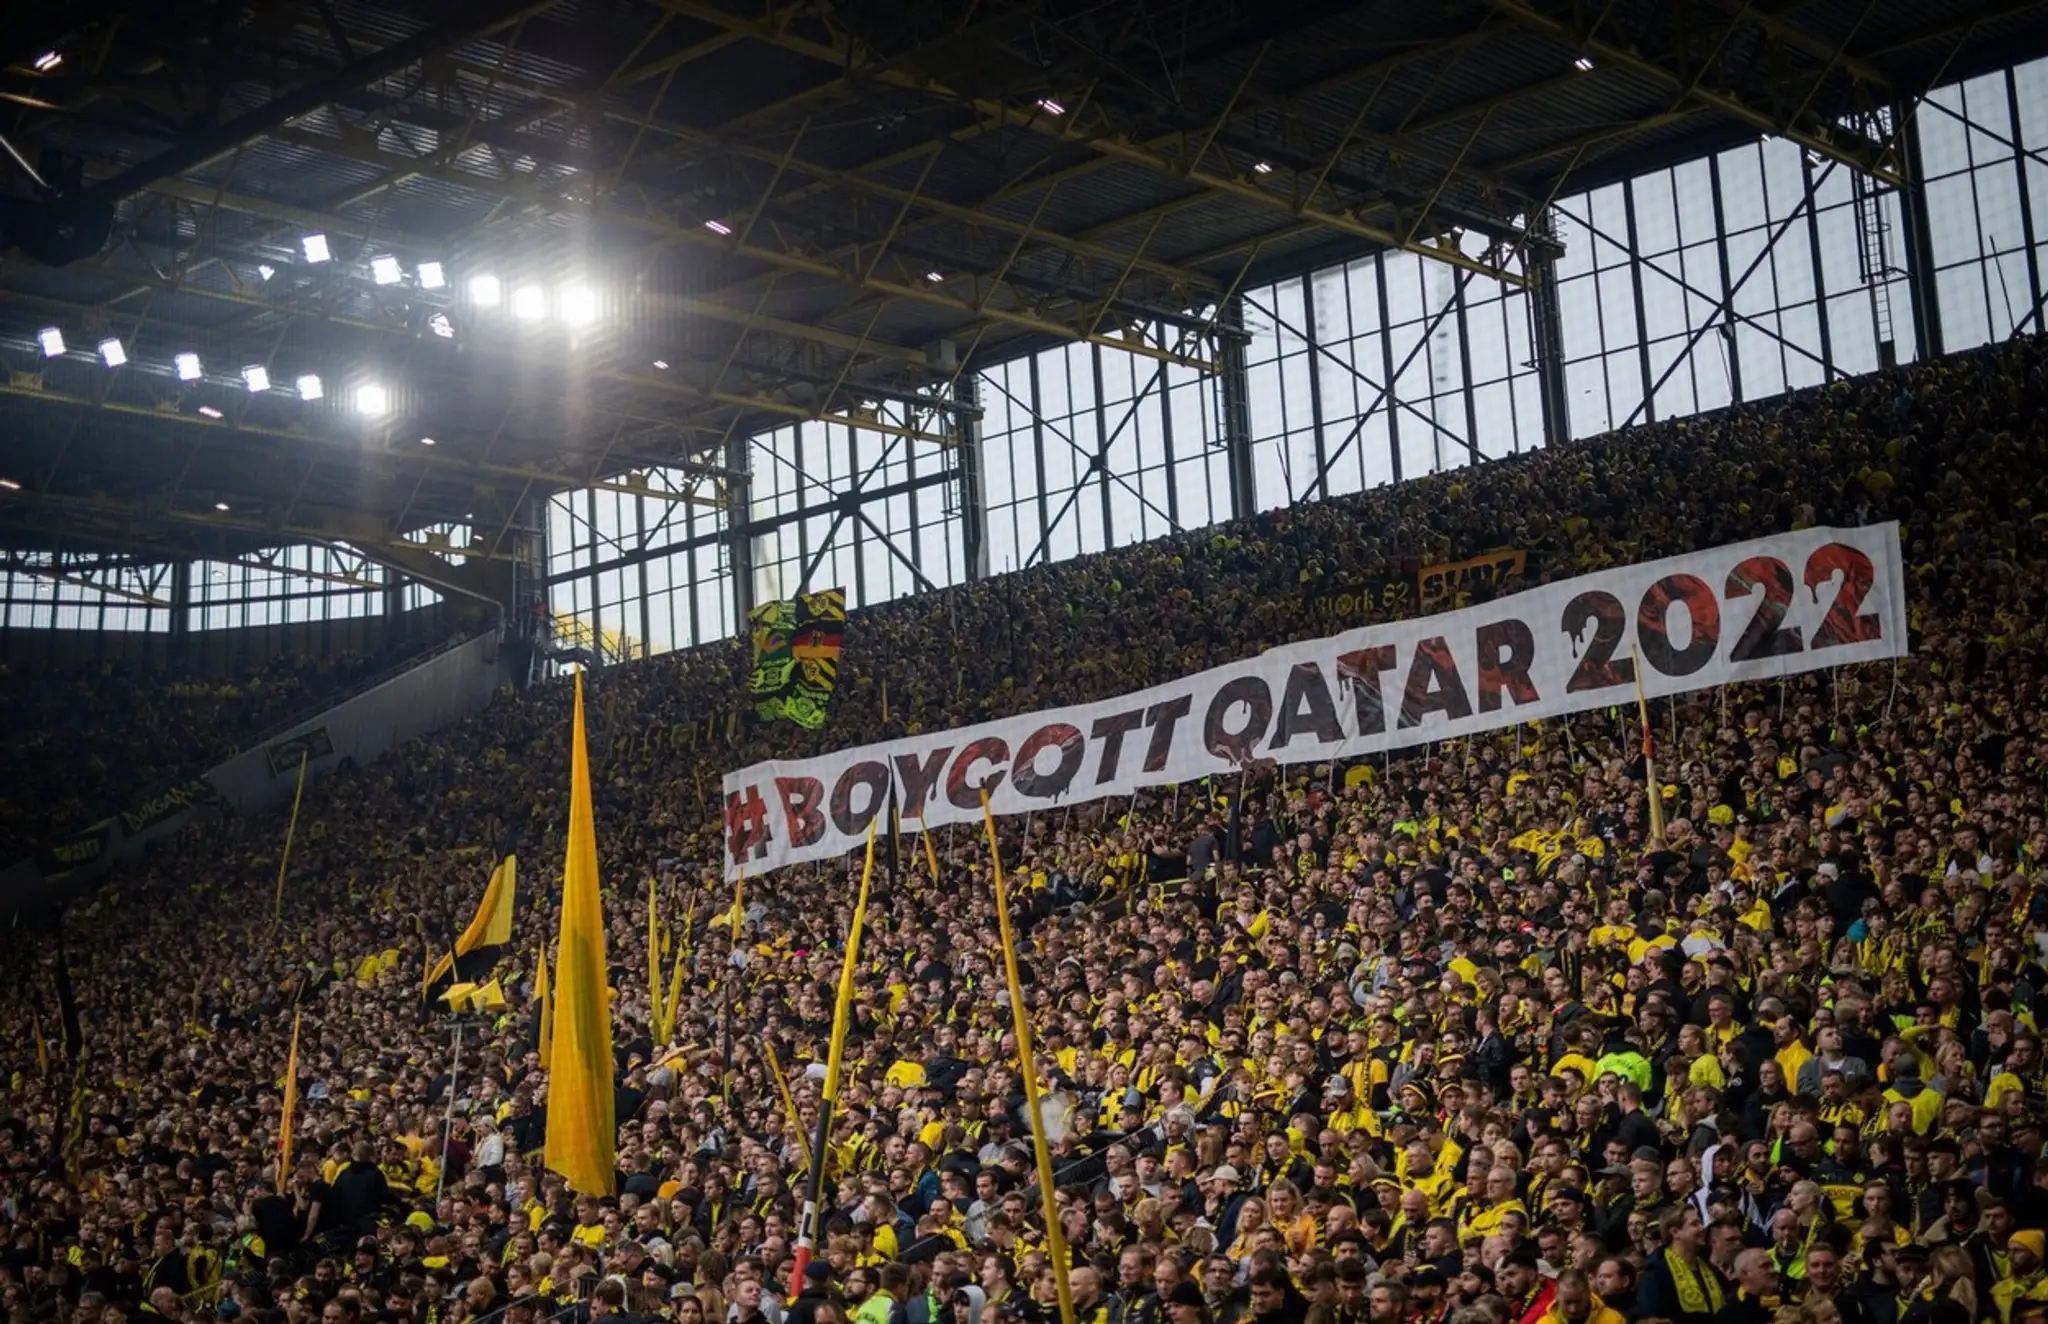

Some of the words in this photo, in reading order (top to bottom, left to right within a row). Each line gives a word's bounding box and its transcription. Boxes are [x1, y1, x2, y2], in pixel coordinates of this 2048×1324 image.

[725, 693, 1193, 865] #BOYCOTT
[1203, 619, 1540, 770] QATAR
[1561, 541, 1882, 692] 2022
